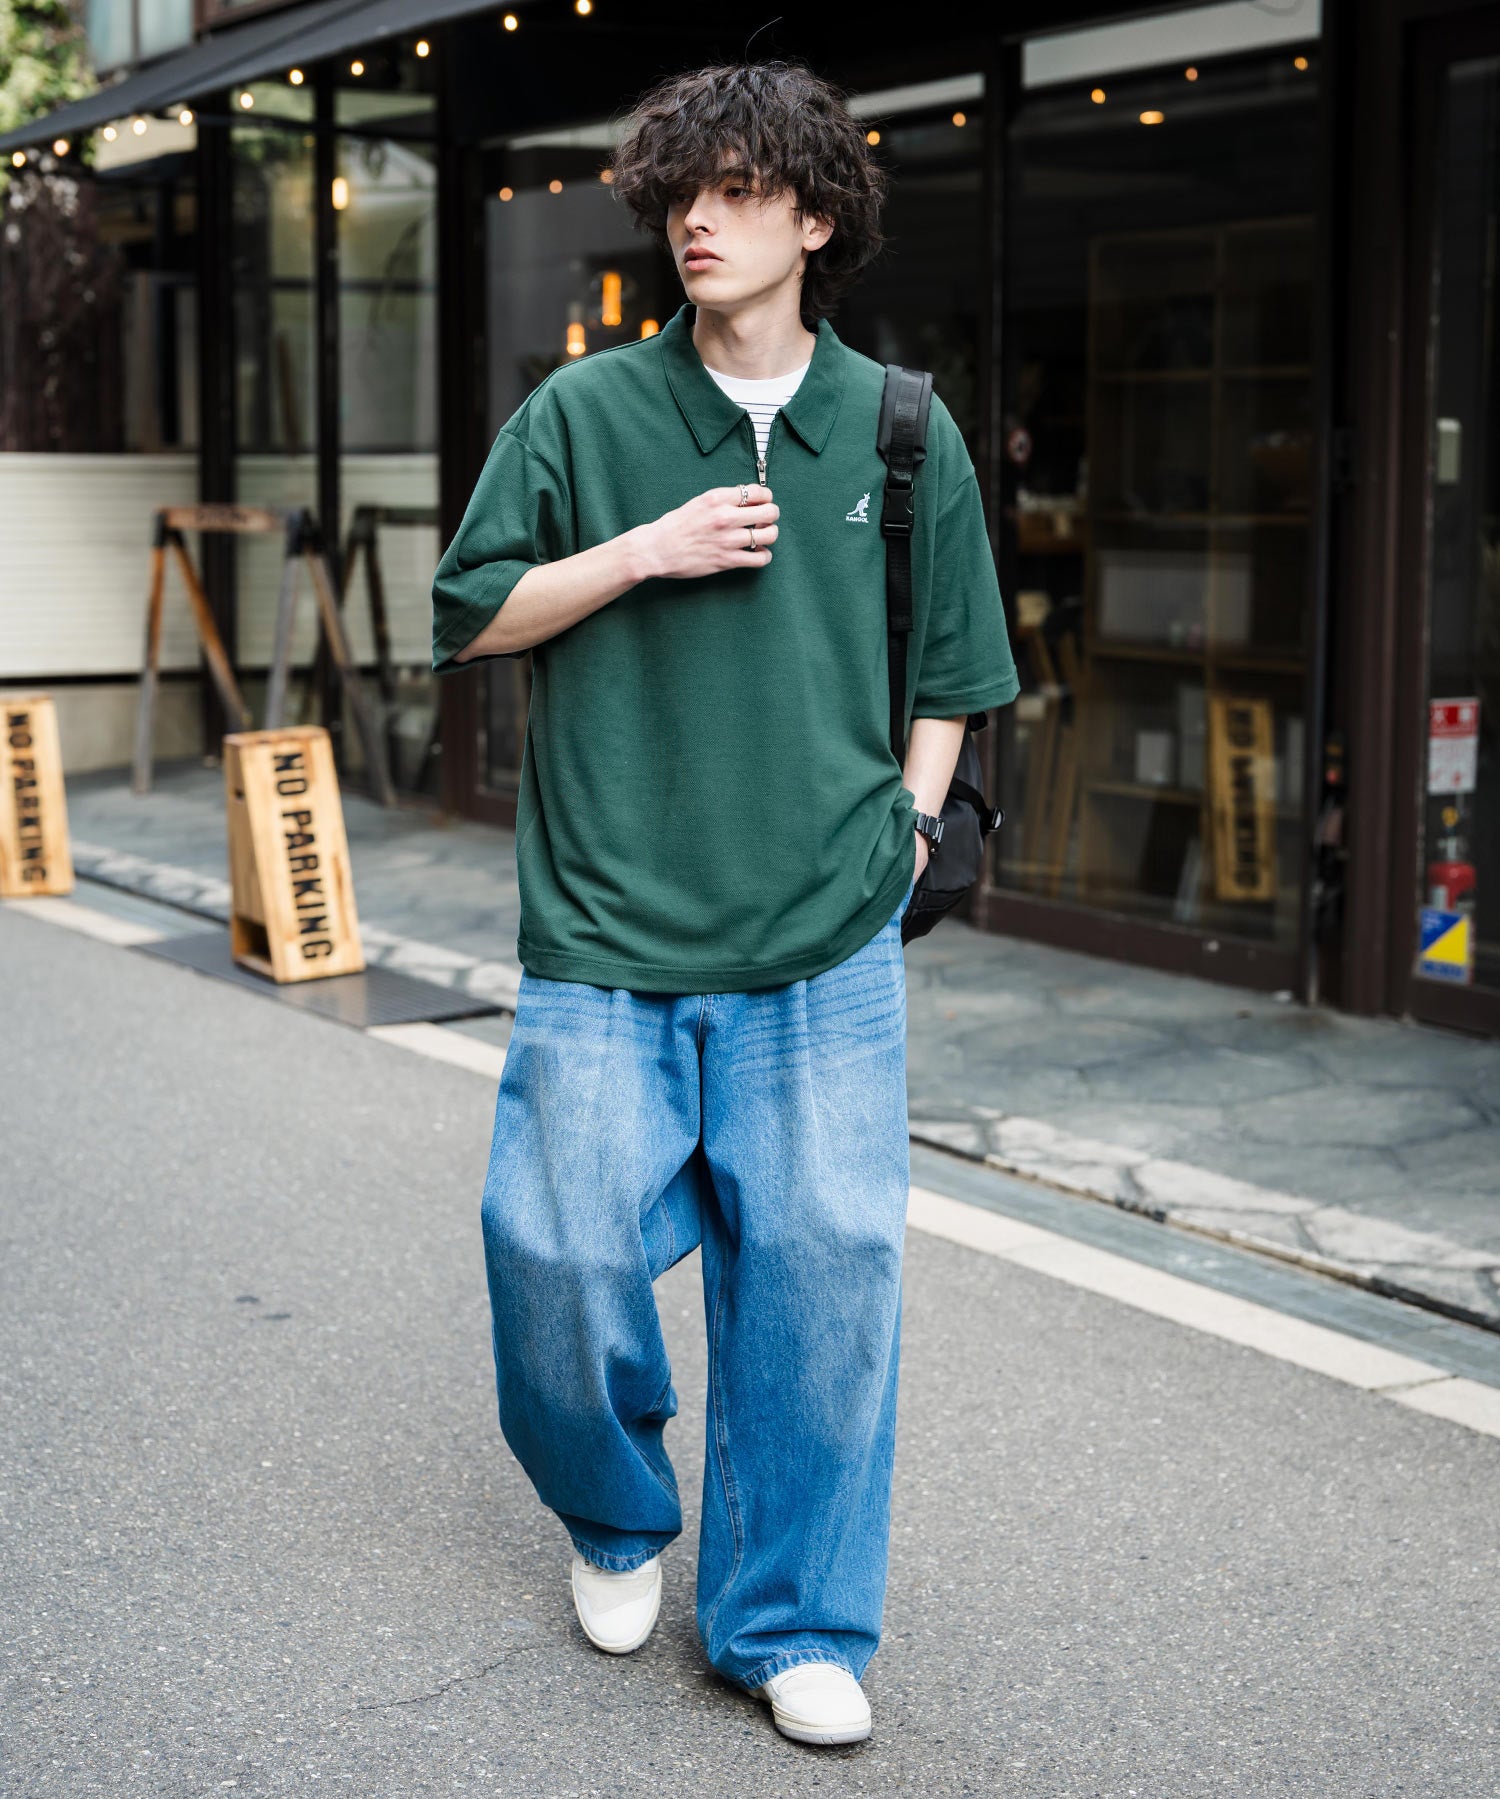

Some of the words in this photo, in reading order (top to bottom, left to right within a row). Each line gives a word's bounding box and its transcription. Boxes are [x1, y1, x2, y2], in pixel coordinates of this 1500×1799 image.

[846, 515, 869, 523] KANGOL
[7, 712, 33, 748] NO
[273, 752, 308, 797] NO
[13, 758, 47, 882] PARKING
[282, 809, 334, 961] PARKING
